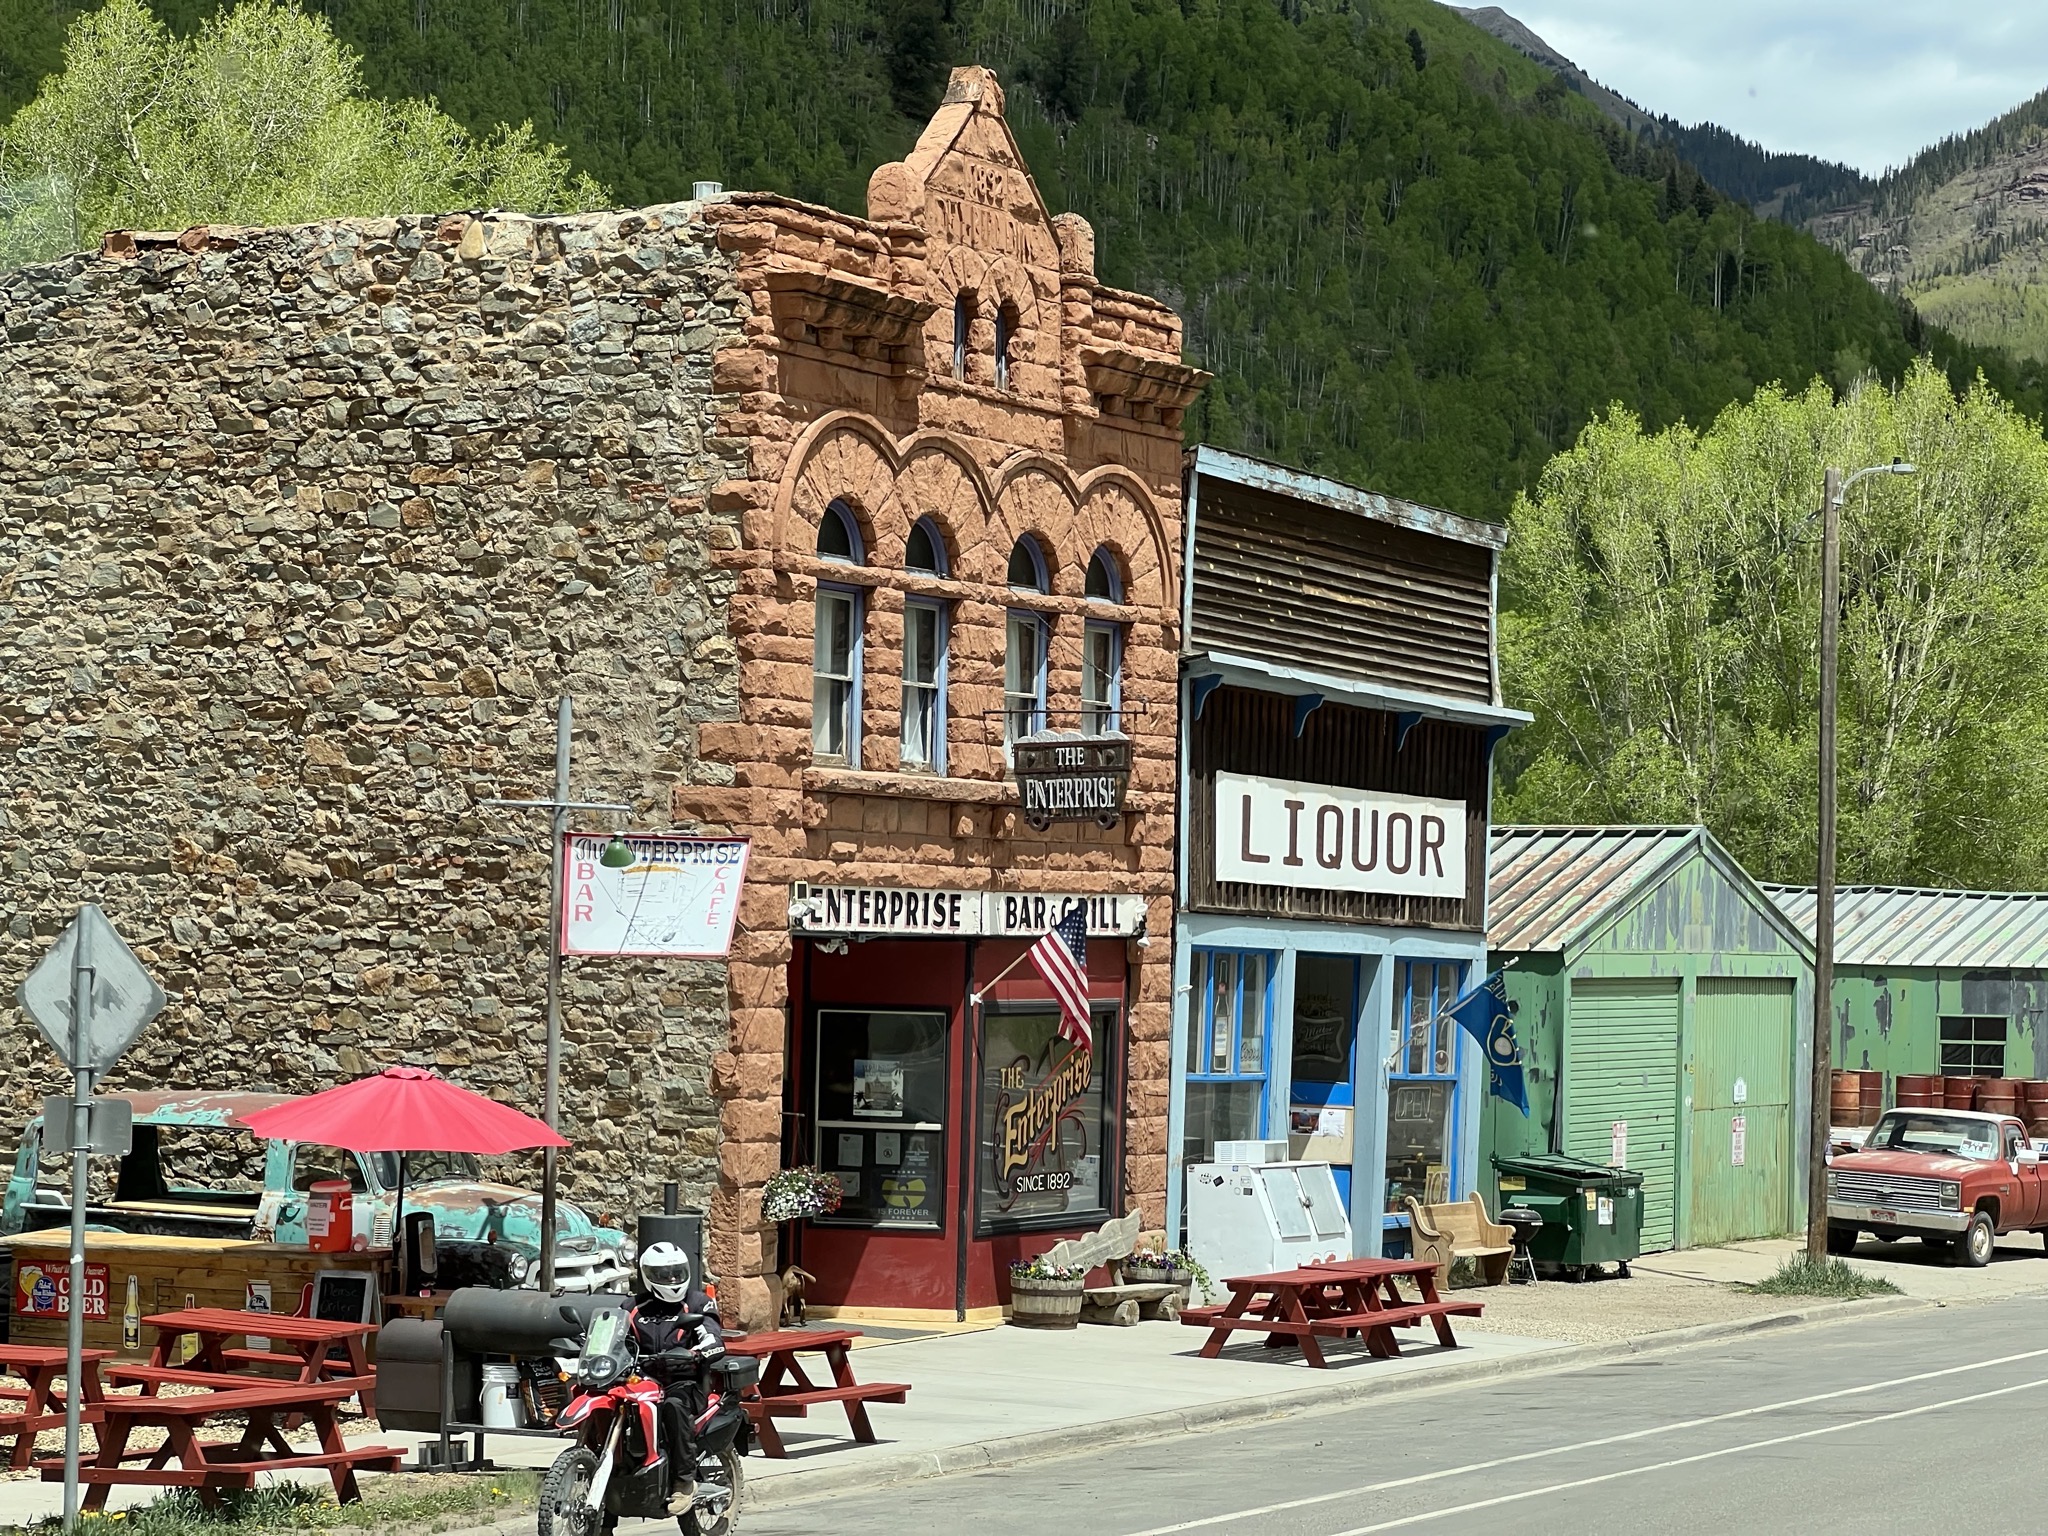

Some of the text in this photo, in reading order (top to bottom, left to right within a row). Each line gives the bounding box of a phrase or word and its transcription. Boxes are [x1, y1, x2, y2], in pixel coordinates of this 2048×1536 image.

[1056, 747, 1085, 766] THE
[1026, 777, 1116, 809] ENTERPRISE
[1242, 795, 1445, 878] LIQUOR
[623, 839, 742, 865] NTERPRISE
[574, 862, 595, 922] BAR
[810, 888, 962, 930] ENTERPRISE
[1006, 896, 1046, 930] BAR
[1050, 904, 1057, 928] &
[1001, 1067, 1024, 1089] THE
[1004, 1050, 1093, 1181] Enterprise
[1397, 1090, 1428, 1118] OPEN
[1962, 1144, 1989, 1153] SALE
[1016, 1172, 1070, 1193] SINCE 1892
[888, 1207, 929, 1216] FOREVER
[58, 1277, 105, 1296] CLD
[57, 1296, 106, 1315] BER
